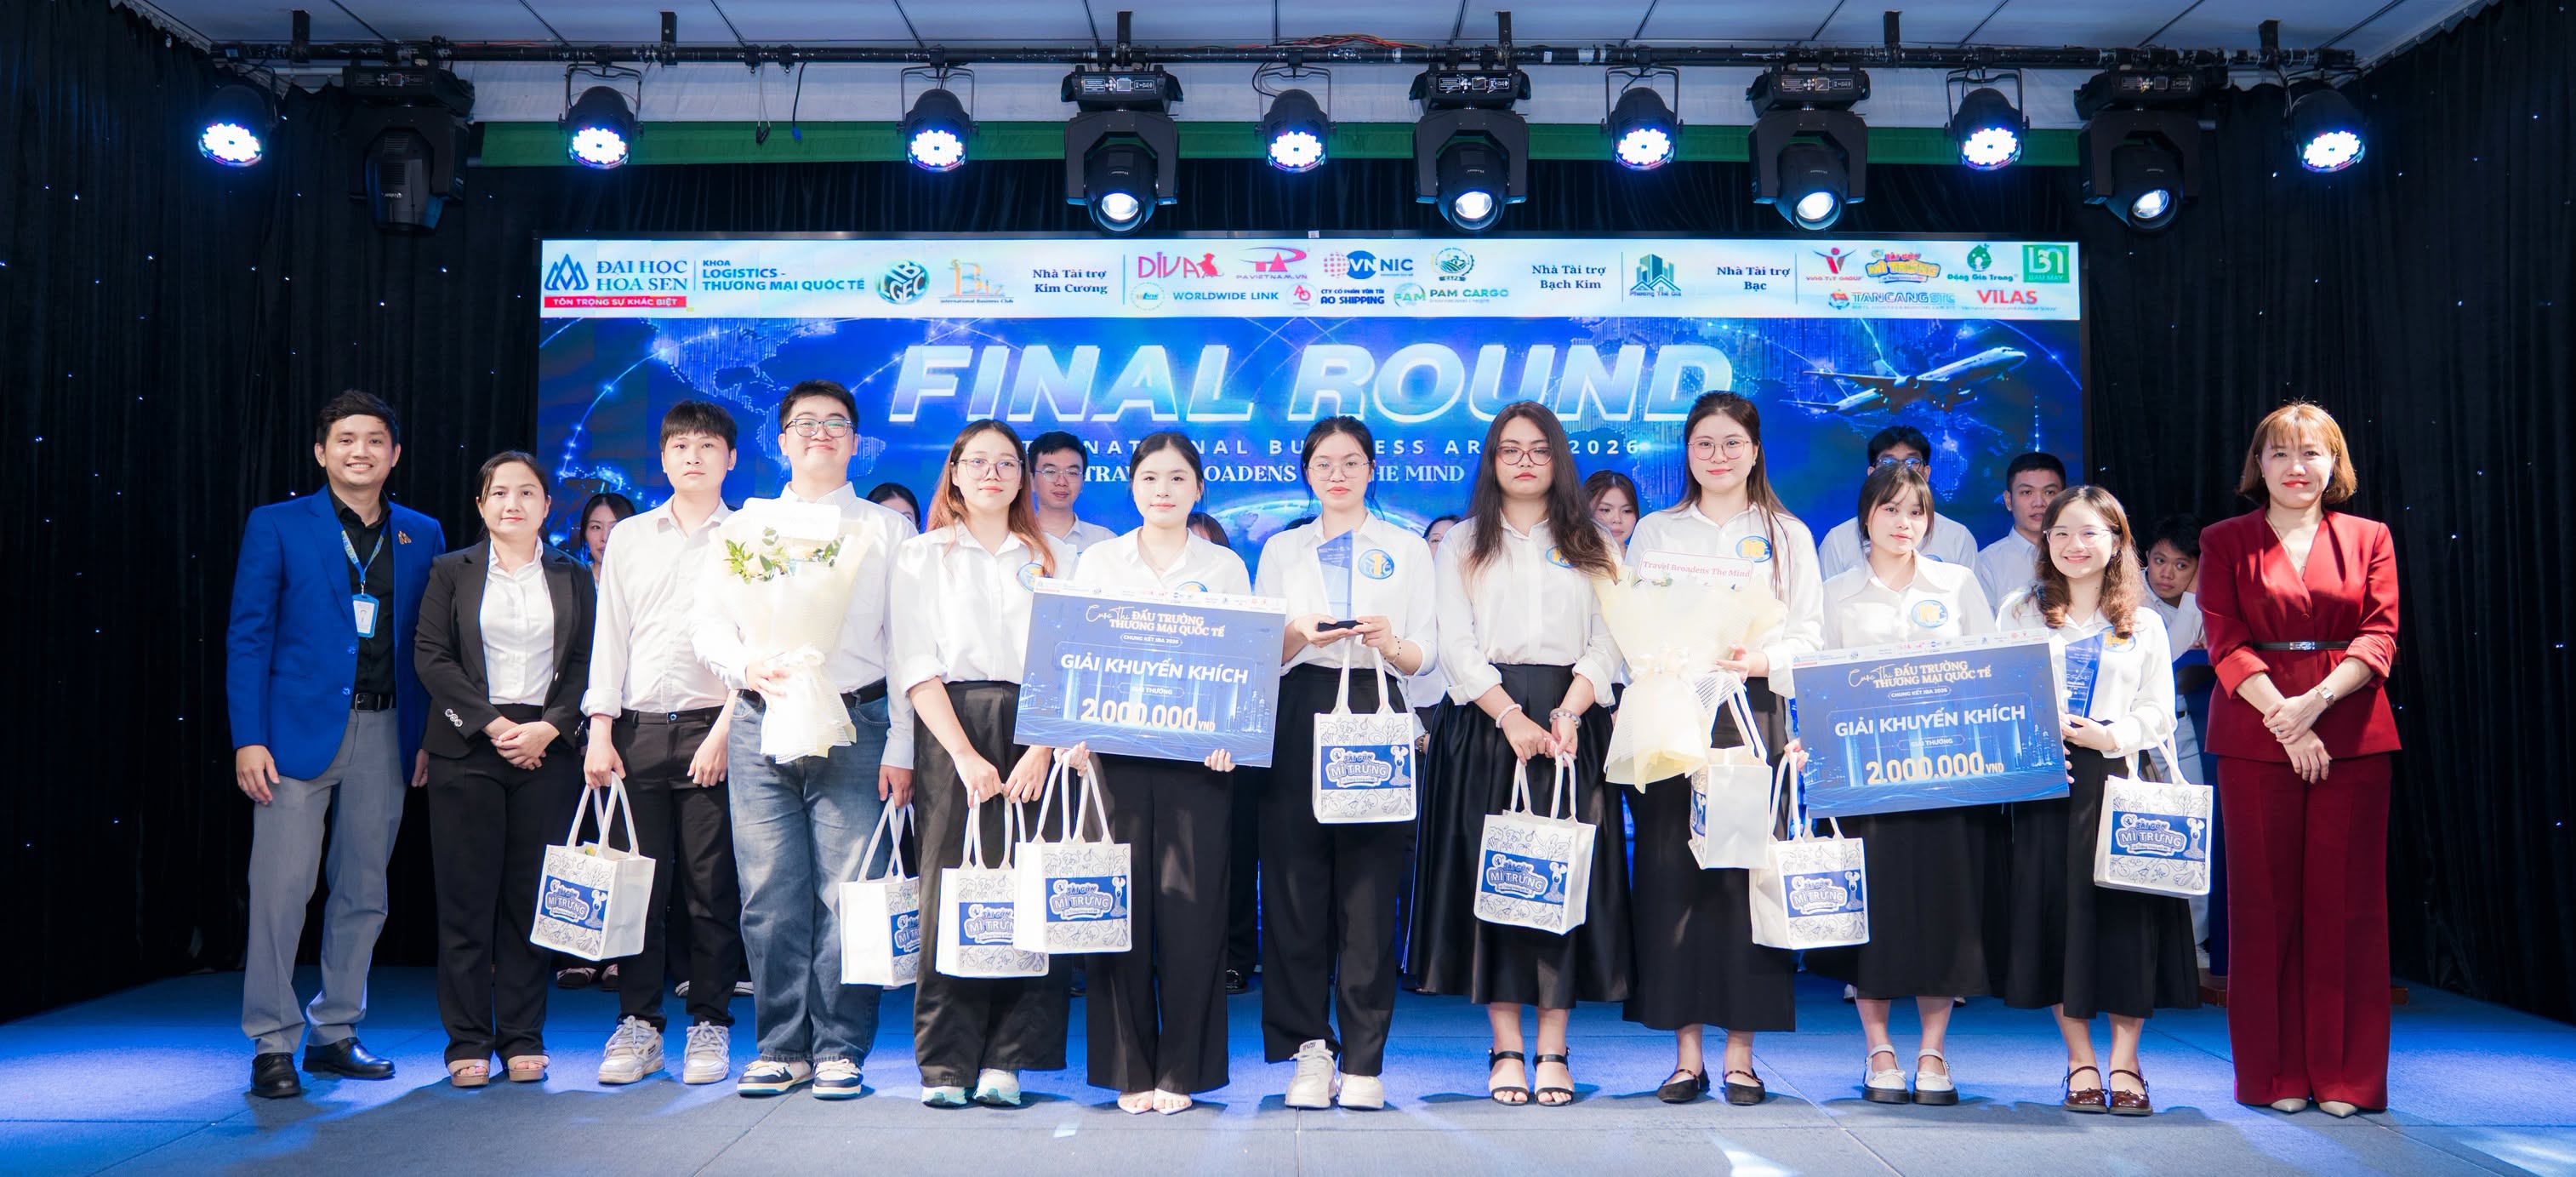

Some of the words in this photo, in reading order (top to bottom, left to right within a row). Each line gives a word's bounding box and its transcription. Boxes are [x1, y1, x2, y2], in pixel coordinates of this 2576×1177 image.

[596, 260, 633, 277] ĐẠI
[640, 260, 687, 276] HỌC
[703, 268, 778, 278] LOGISTICS
[1033, 269, 1058, 278] Nhà
[1062, 269, 1082, 278] Tài
[1086, 270, 1107, 282] trợ
[1532, 265, 1559, 274] Nhà
[1562, 265, 1582, 274] Tài
[1586, 266, 1606, 276] trợ
[1717, 266, 1742, 276] Nhà
[1746, 266, 1767, 276] Tài
[1770, 267, 1790, 277] trợ
[596, 277, 642, 290] HOA
[647, 277, 687, 290] SEN
[703, 279, 767, 290] THƯƠNG
[769, 280, 798, 293] MẠI
[802, 278, 845, 290] QUỐC
[848, 277, 865, 290] TẾ
[1034, 283, 1061, 293] Kim
[1064, 283, 1108, 296] Cương
[1540, 279, 1571, 290] Bạch
[1575, 279, 1601, 289] Kim
[1744, 281, 1767, 292] Bạc
[577, 299, 609, 308] TRỌNG
[627, 297, 653, 306] KHÁC
[656, 298, 678, 307] BIỆT
[1173, 292, 1247, 300] WORLDWIDE
[1251, 292, 1279, 300] LINK
[1339, 296, 1385, 305] SHIPPING
[1851, 292, 1929, 303] TANCANG
[1977, 289, 2037, 305] VILAS
[889, 345, 1255, 423] FINAL
[1287, 342, 1734, 424] ROUND
[1570, 440, 1638, 454] 2026
[1203, 465, 1297, 483] OADENS
[1405, 465, 1465, 483] MIND
[1643, 561, 1670, 571] Travel
[1672, 563, 1709, 574] Broadens
[1712, 568, 1726, 577] The
[1729, 569, 1751, 579] Mind
[1131, 607, 1155, 622] ĐẤU
[1158, 610, 1204, 626] TRƯỜNG
[1109, 619, 1154, 631] THƯƠNG
[1156, 622, 1177, 635] MẠI
[1180, 623, 1209, 637] QUỐC
[1211, 624, 1226, 637] TẾ
[1061, 652, 1101, 670] GIẢI
[1104, 657, 1184, 679] KHUYẾN
[1188, 664, 1249, 684] KHÍCH
[1894, 662, 1918, 677] ĐẤU
[1919, 660, 1968, 675] TRƯỜNG
[1873, 674, 1919, 688] THƯƠNG
[1922, 672, 1943, 686] MẠI
[1945, 669, 1974, 684] QUỐC
[1976, 665, 1992, 678] TẾ
[1080, 698, 1198, 732] 2.000.000
[1198, 720, 1216, 732] VND
[1835, 716, 1874, 737] GIẢI
[1879, 707, 1958, 734] KHUYẾN
[1964, 704, 2026, 725] KHÍCH
[1331, 763, 1347, 777] MÌ
[1348, 763, 1388, 777] TRỨNG
[1866, 751, 1985, 786] 2.000.000
[1986, 762, 2004, 774] VND
[2119, 830, 2136, 843] MÌ
[2139, 829, 2182, 848] TRỨNG
[1490, 869, 1504, 882] MÌ
[1505, 871, 1544, 889] TRỨNG
[1055, 894, 1069, 909] MÌ
[1070, 894, 1108, 908] TRỨNG
[1809, 888, 1844, 902] TRỨNG
[558, 897, 586, 916] TRỨNG
[970, 918, 983, 934] MÌ
